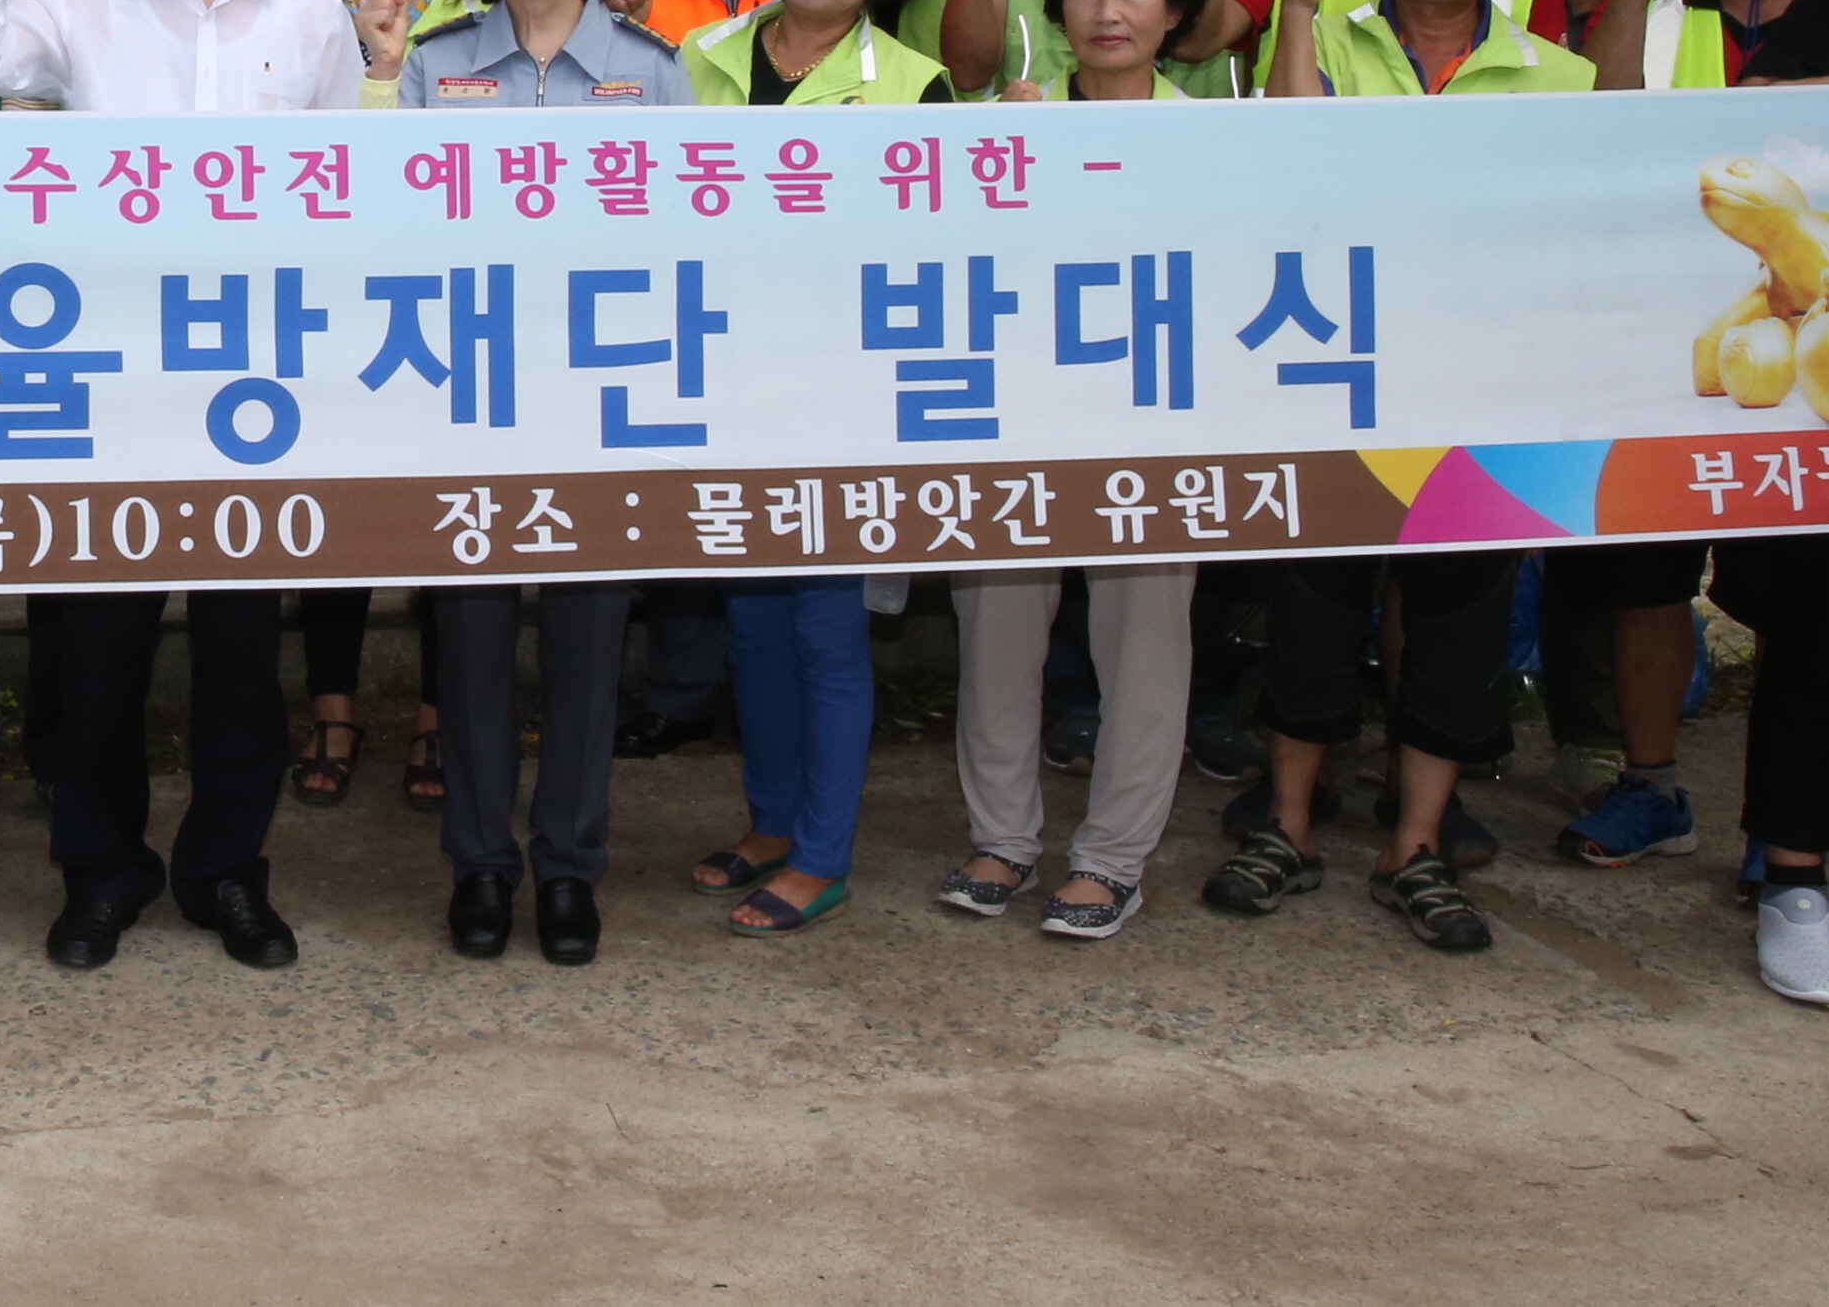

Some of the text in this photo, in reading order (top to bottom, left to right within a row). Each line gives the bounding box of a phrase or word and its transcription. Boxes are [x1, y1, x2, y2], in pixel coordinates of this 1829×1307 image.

[4, 144, 352, 224] 수상안전
[404, 139, 833, 219] 예방활동을
[880, 136, 1037, 212] 위한
[861, 245, 1377, 443] 발대식
[431, 485, 580, 566] 장소
[685, 475, 1052, 556] 물레방앗간
[1093, 461, 1303, 545] 유원지
